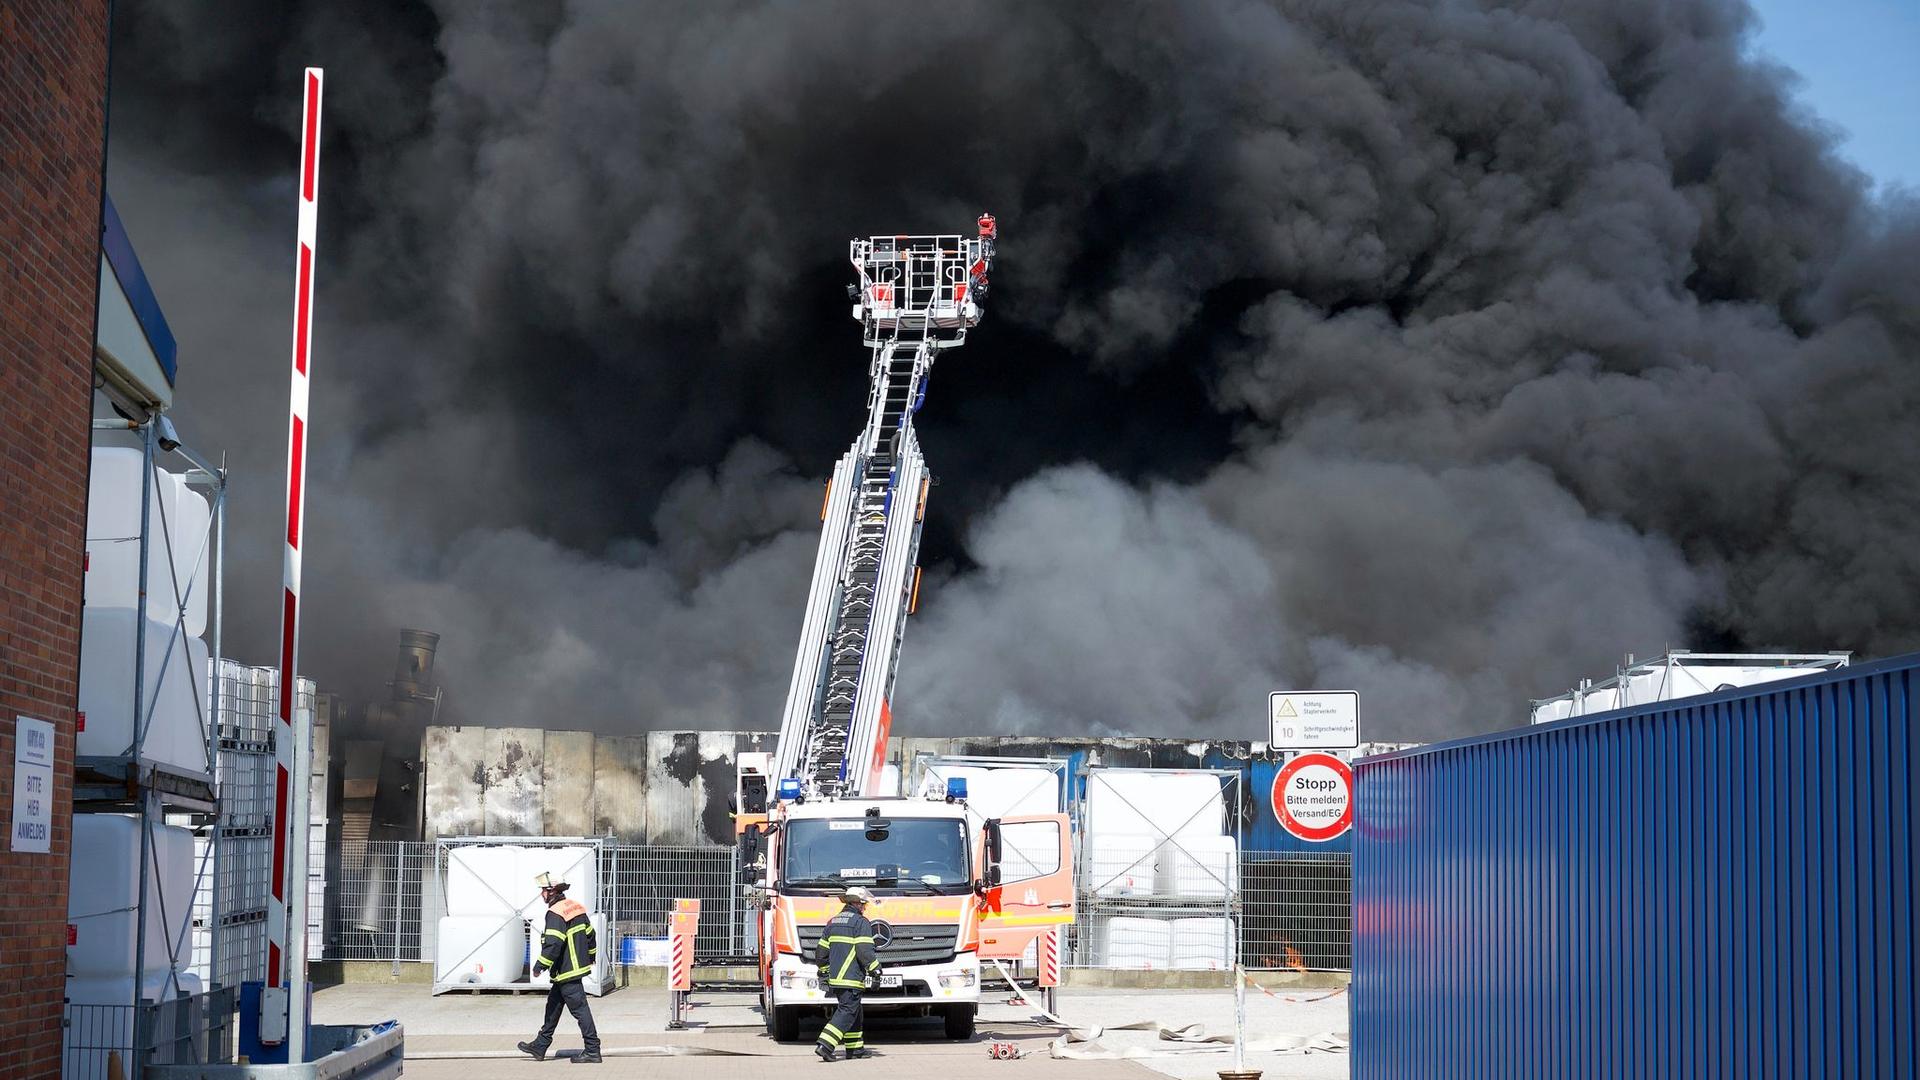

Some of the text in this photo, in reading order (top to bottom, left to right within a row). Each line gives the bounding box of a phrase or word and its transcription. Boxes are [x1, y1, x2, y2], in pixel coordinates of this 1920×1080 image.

[1282, 727, 1294, 738] 10
[26, 775, 42, 794] BITTE
[1295, 777, 1337, 792] Stopp
[1287, 795, 1346, 805] Bitte melden!
[26, 799, 40, 817] HIER
[1292, 808, 1342, 818] Versand/EG
[17, 821, 46, 841] ANMELDEN
